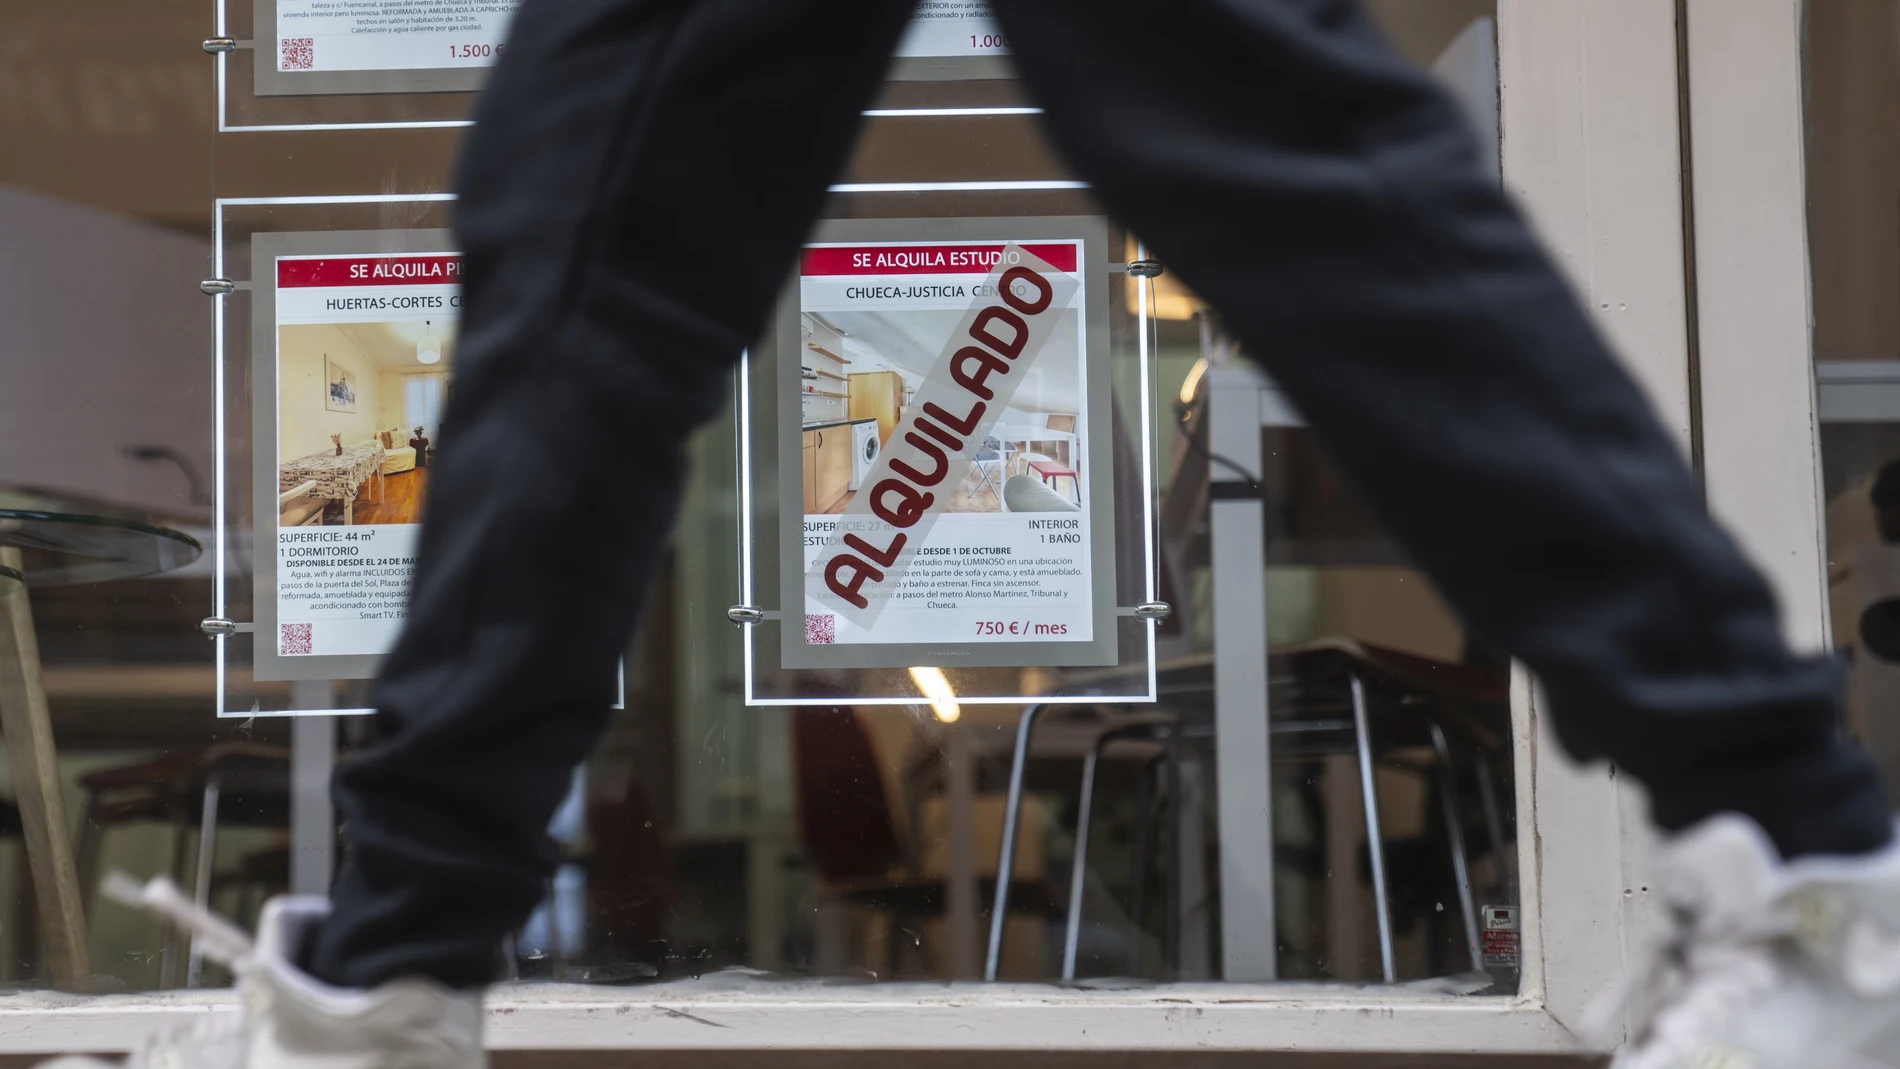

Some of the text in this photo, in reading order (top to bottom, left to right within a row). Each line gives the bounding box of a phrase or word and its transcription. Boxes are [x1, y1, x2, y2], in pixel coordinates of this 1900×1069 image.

[450, 44, 490, 58] 1.500
[852, 251, 1020, 268] SE ALQUILA ESTUDIO
[350, 262, 469, 278] SE ALQUILA PIS
[846, 286, 965, 299] CHUECA-JUSTICIA
[326, 296, 442, 310] HUERTAS-CORTES
[824, 266, 1053, 609] ALQUILADO
[1028, 520, 1078, 530] INTERIOR
[280, 532, 342, 543] SUPERFICIE:
[344, 532, 358, 541] 44
[1040, 532, 1081, 544] 1 BAÑO
[280, 546, 359, 557] 1 DORMITORIO
[286, 560, 336, 568] DISPONIBLE
[290, 570, 312, 579] Agua,
[314, 570, 328, 578] wifi
[363, 568, 406, 576] INCLUIDOS
[932, 570, 952, 578] parte
[364, 580, 378, 588] Sol,
[380, 579, 400, 587] Plaza
[282, 592, 322, 600] reformada,
[324, 590, 366, 598] amueblada
[310, 601, 366, 610] acondicionado
[360, 612, 382, 620] Smart
[976, 621, 1067, 636] 750 € / mes
